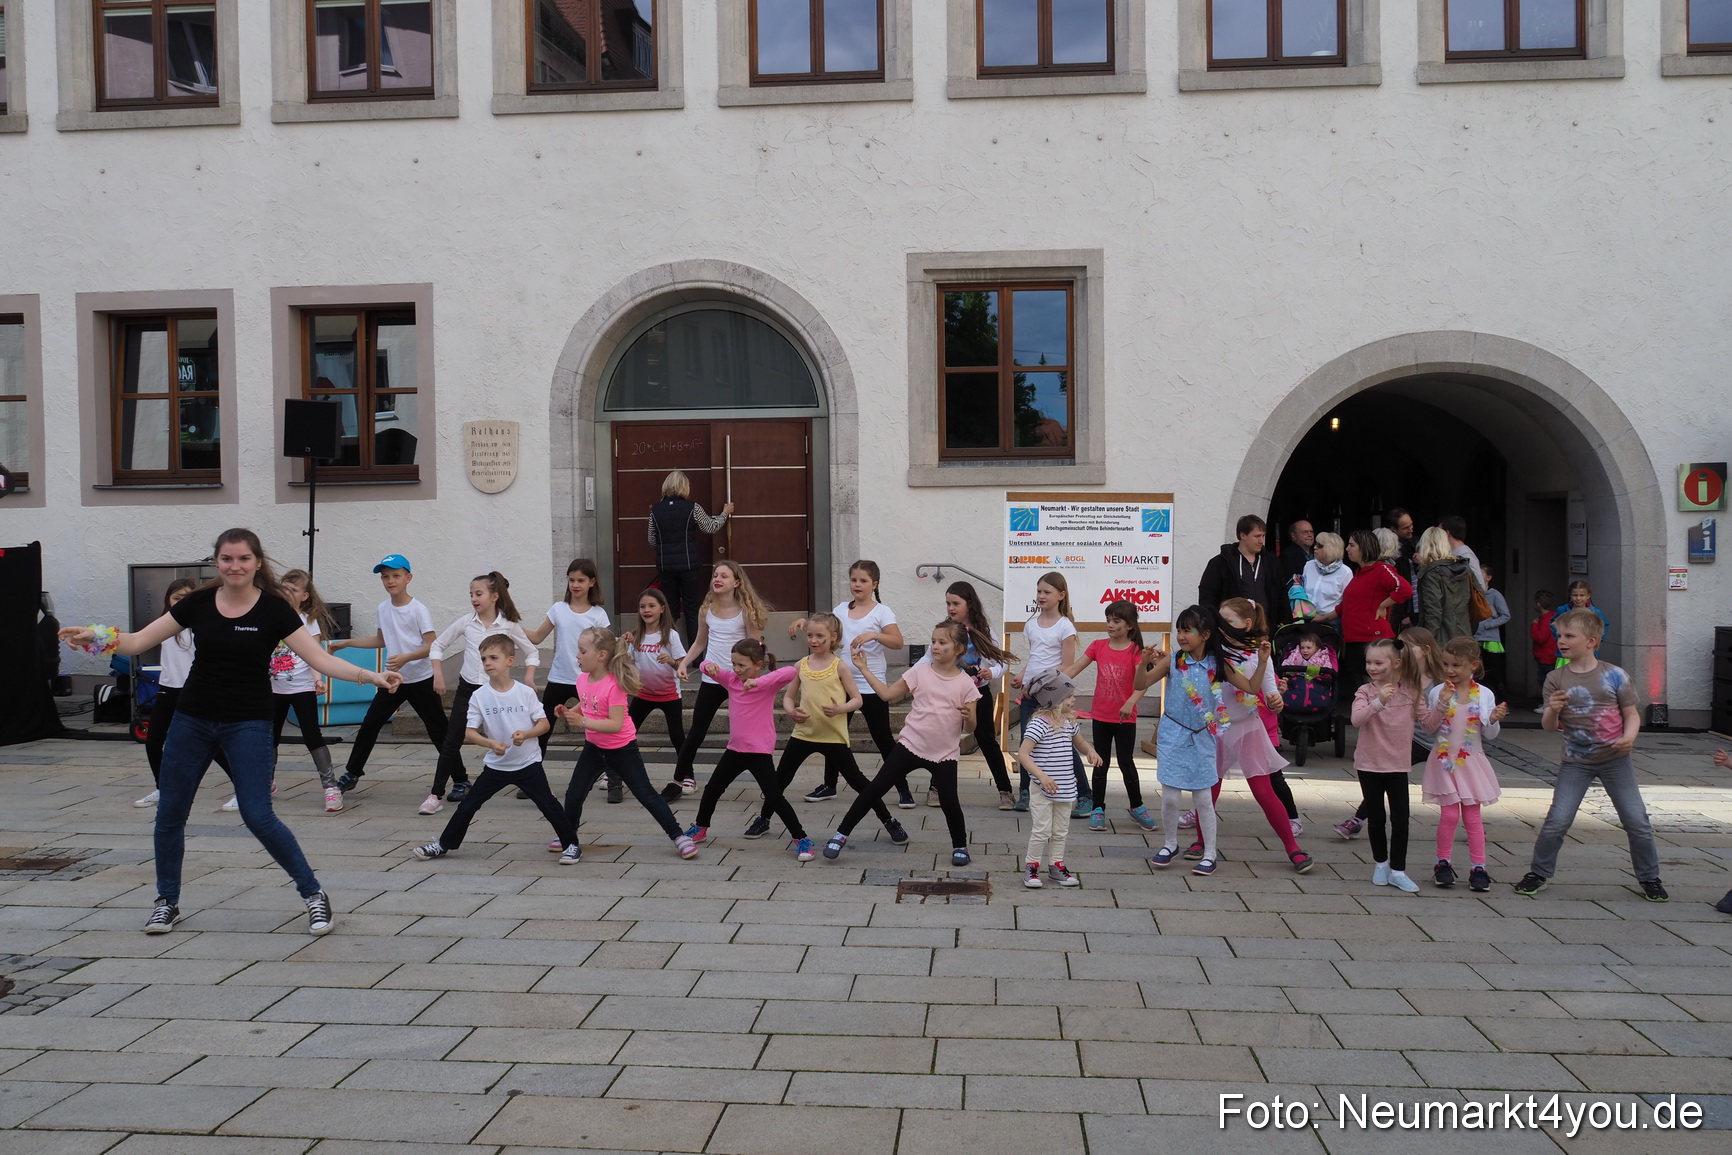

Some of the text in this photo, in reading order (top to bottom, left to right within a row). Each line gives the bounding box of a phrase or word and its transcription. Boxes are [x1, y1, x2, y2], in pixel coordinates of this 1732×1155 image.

[1081, 505, 1105, 513] gestalten
[1103, 555, 1160, 564] NEUMARKT
[485, 705, 524, 716] ESPRIT
